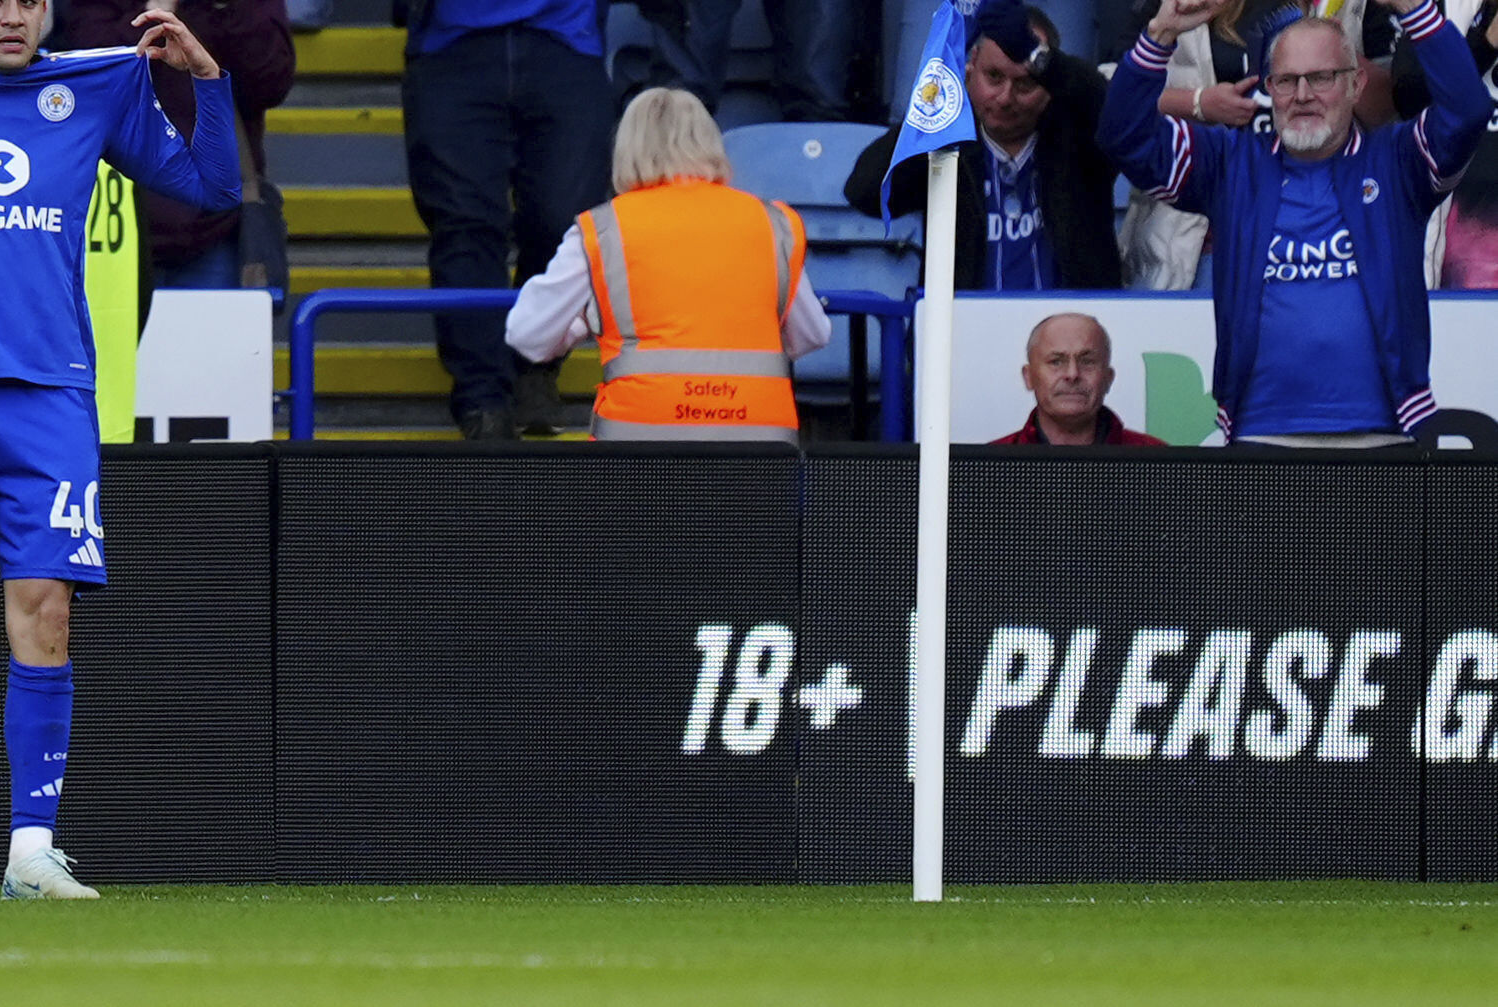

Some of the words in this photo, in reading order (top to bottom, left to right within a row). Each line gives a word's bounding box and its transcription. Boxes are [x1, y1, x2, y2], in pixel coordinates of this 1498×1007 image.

[1267, 228, 1354, 264] KING
[1263, 259, 1359, 283] POWER
[684, 381, 738, 400] Safety
[675, 404, 747, 421] Steward
[49, 480, 104, 539] 40
[683, 623, 863, 755] 18+
[959, 626, 1401, 761] PLEASE
[1411, 629, 1498, 762] G
